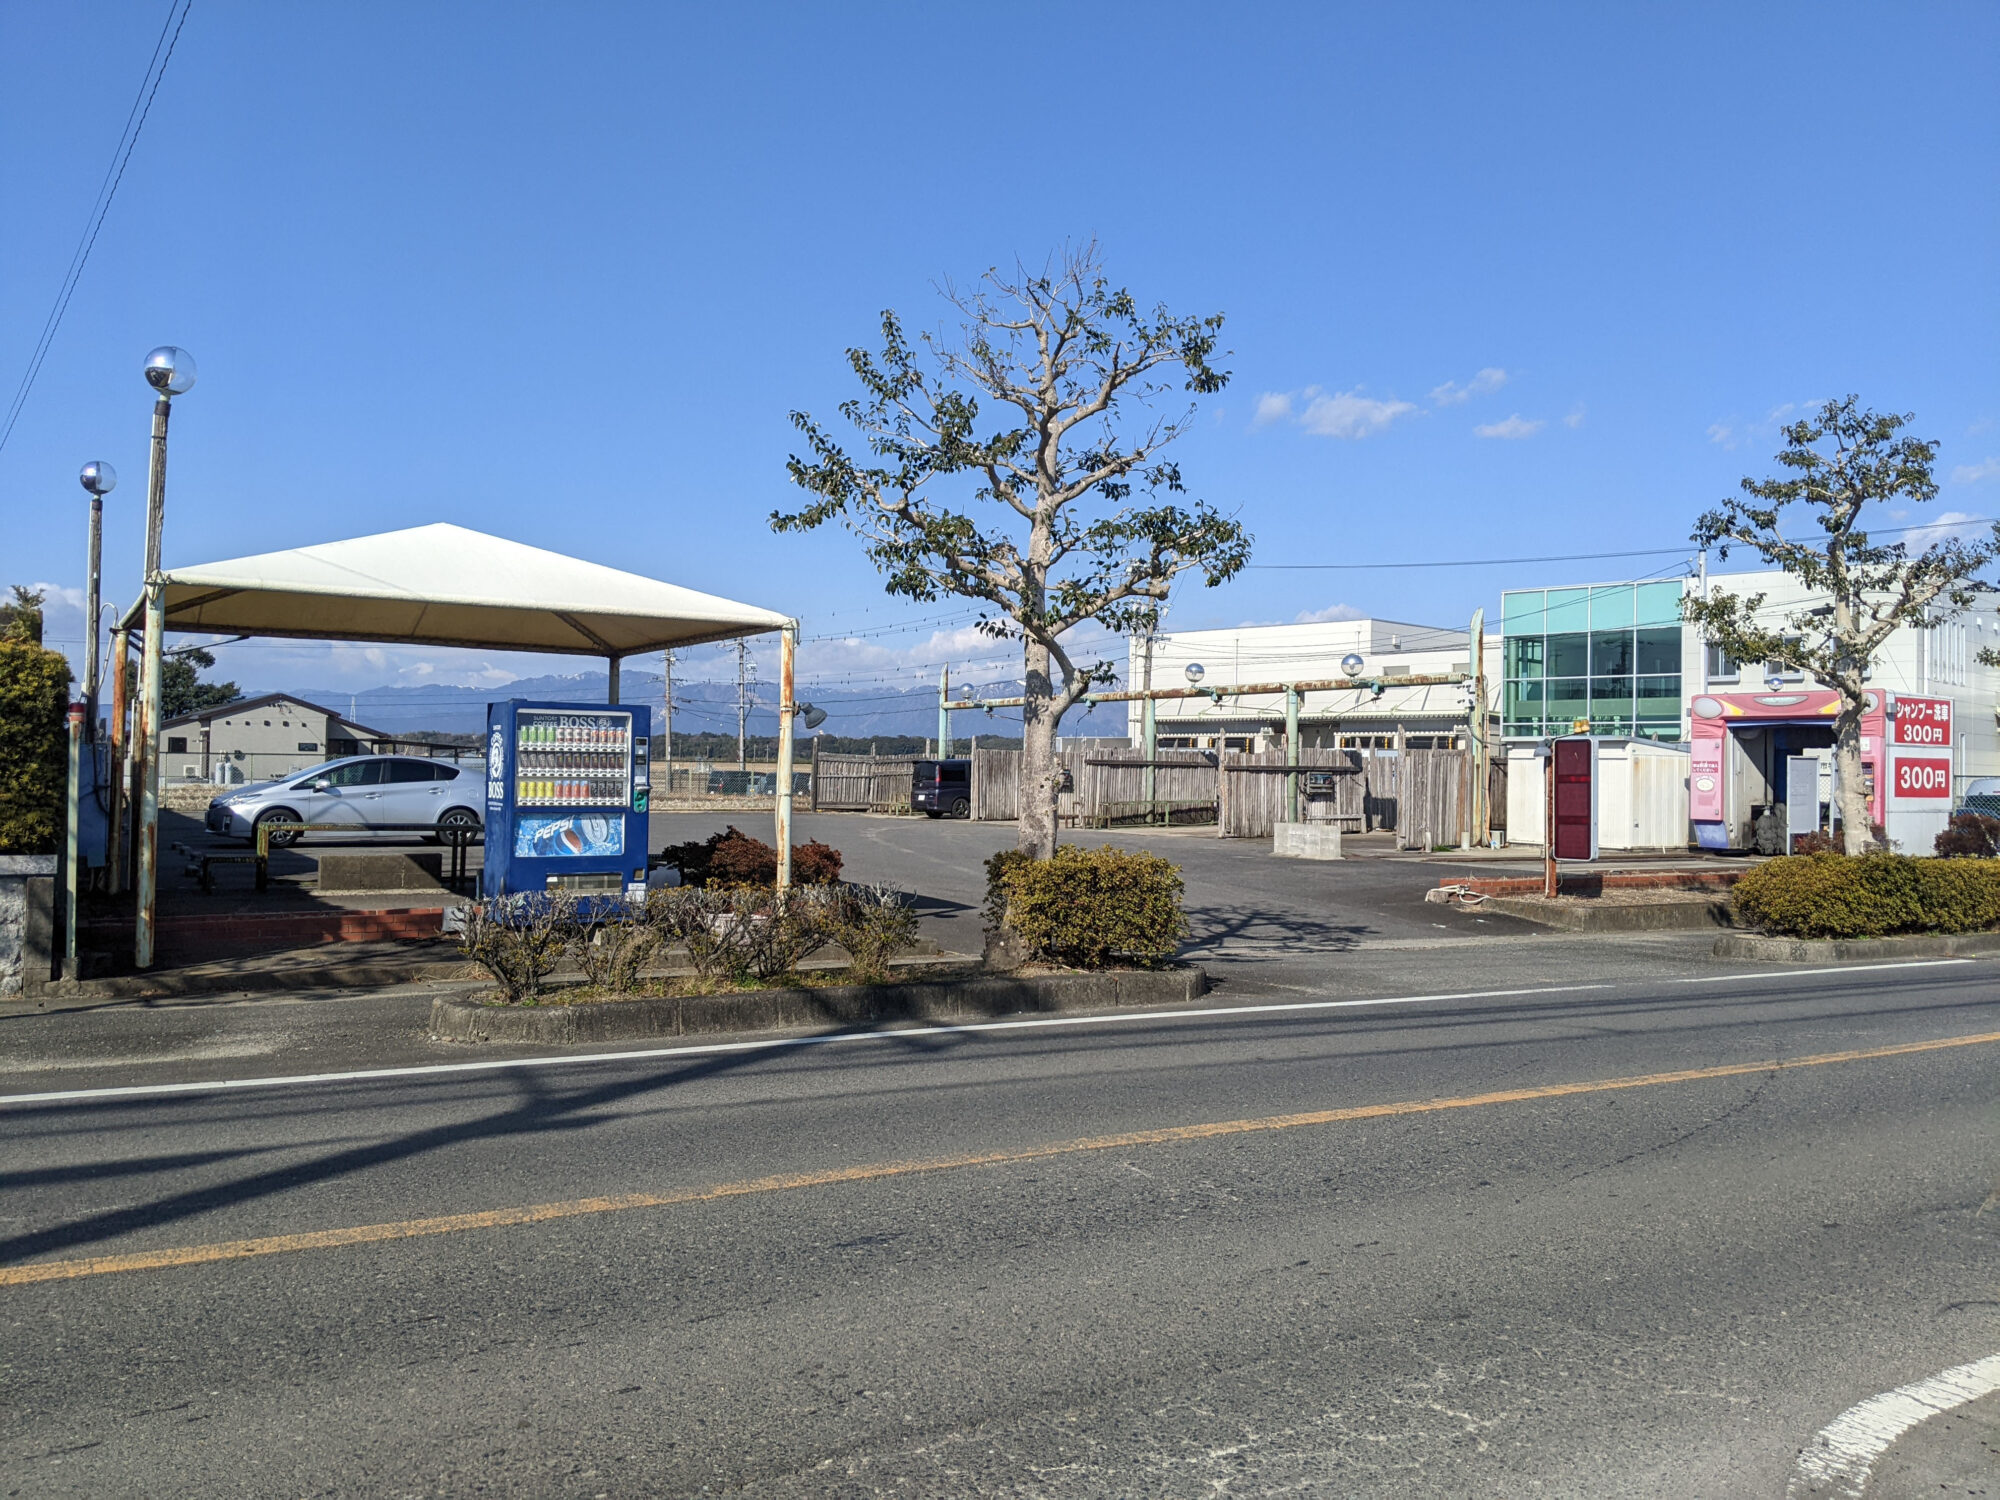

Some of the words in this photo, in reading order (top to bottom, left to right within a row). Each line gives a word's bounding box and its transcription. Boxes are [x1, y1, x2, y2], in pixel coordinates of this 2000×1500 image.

[560, 716, 596, 728] BOSS
[1903, 724, 1943, 742] 300円
[1900, 766, 1946, 789] 300円
[488, 781, 504, 799] BOSS
[534, 815, 575, 843] PEPSI
